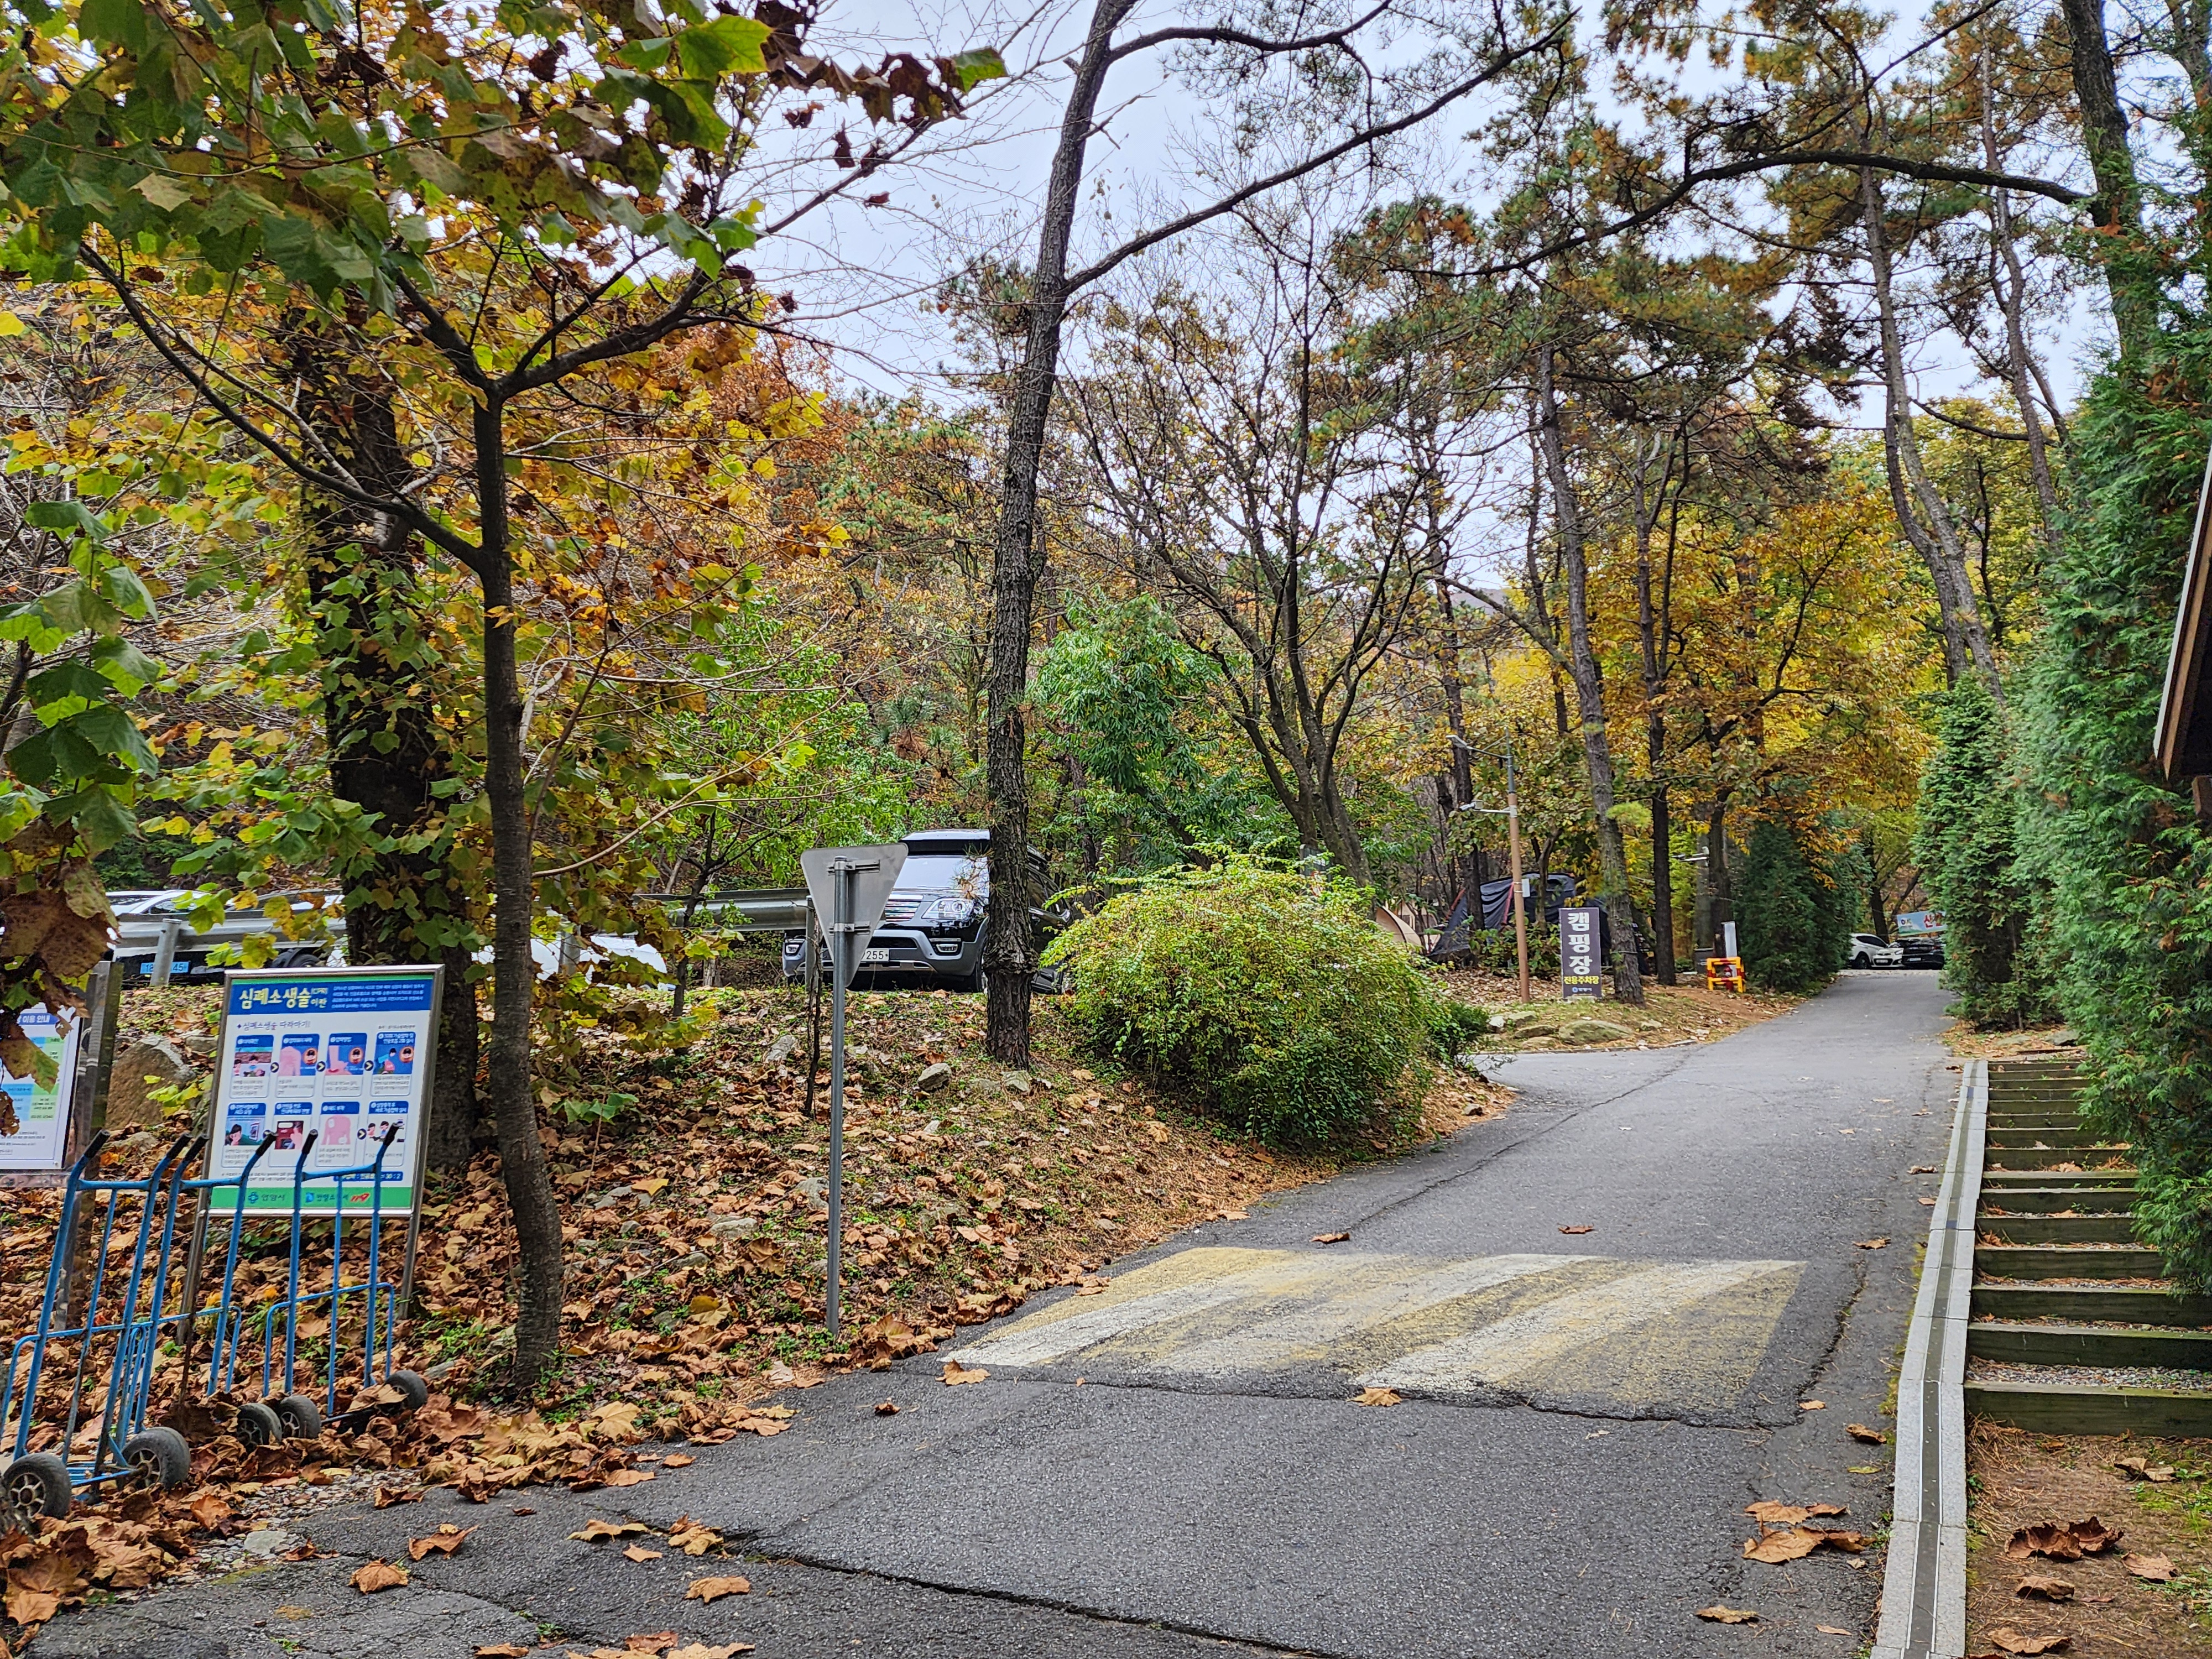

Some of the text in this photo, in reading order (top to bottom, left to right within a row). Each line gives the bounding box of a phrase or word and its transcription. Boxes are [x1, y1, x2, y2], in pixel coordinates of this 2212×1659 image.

[1567, 912, 1593, 975] 캠핑장
[1564, 975, 1599, 984] 전용주차장
[239, 987, 311, 1009] 심폐소생술
[242, 1021, 278, 1031] 심폐소생술
